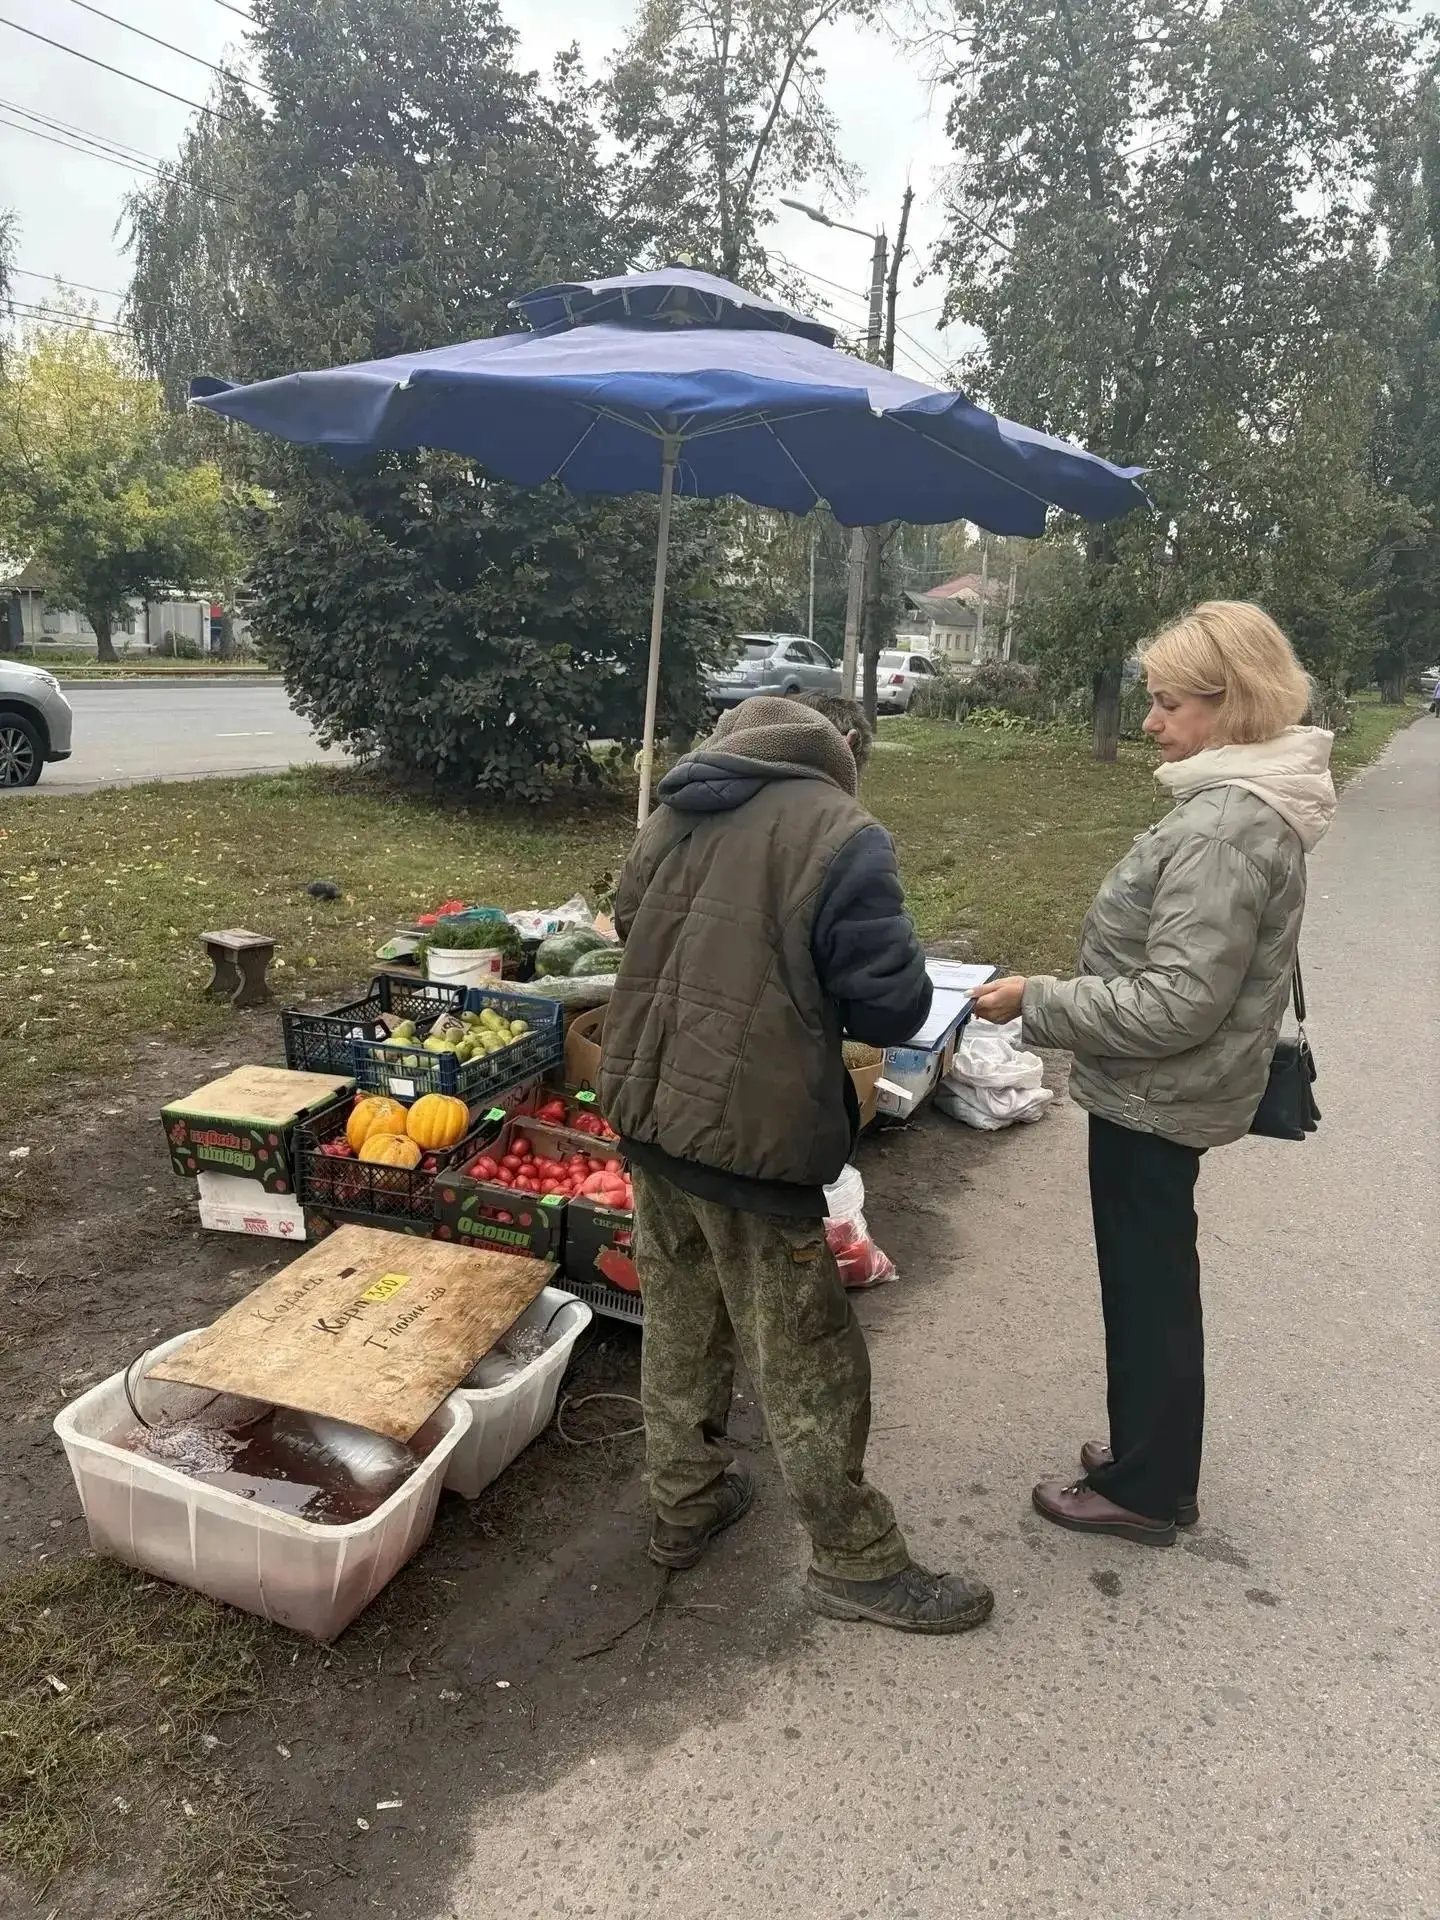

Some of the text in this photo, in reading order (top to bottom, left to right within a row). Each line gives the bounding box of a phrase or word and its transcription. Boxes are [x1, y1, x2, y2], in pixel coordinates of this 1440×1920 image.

[197, 1144, 256, 1171] Овощи
[457, 1216, 531, 1247] Овощи
[250, 1277, 324, 1323] Карась
[368, 1279, 399, 1299] 350
[312, 1300, 370, 1335] Карп
